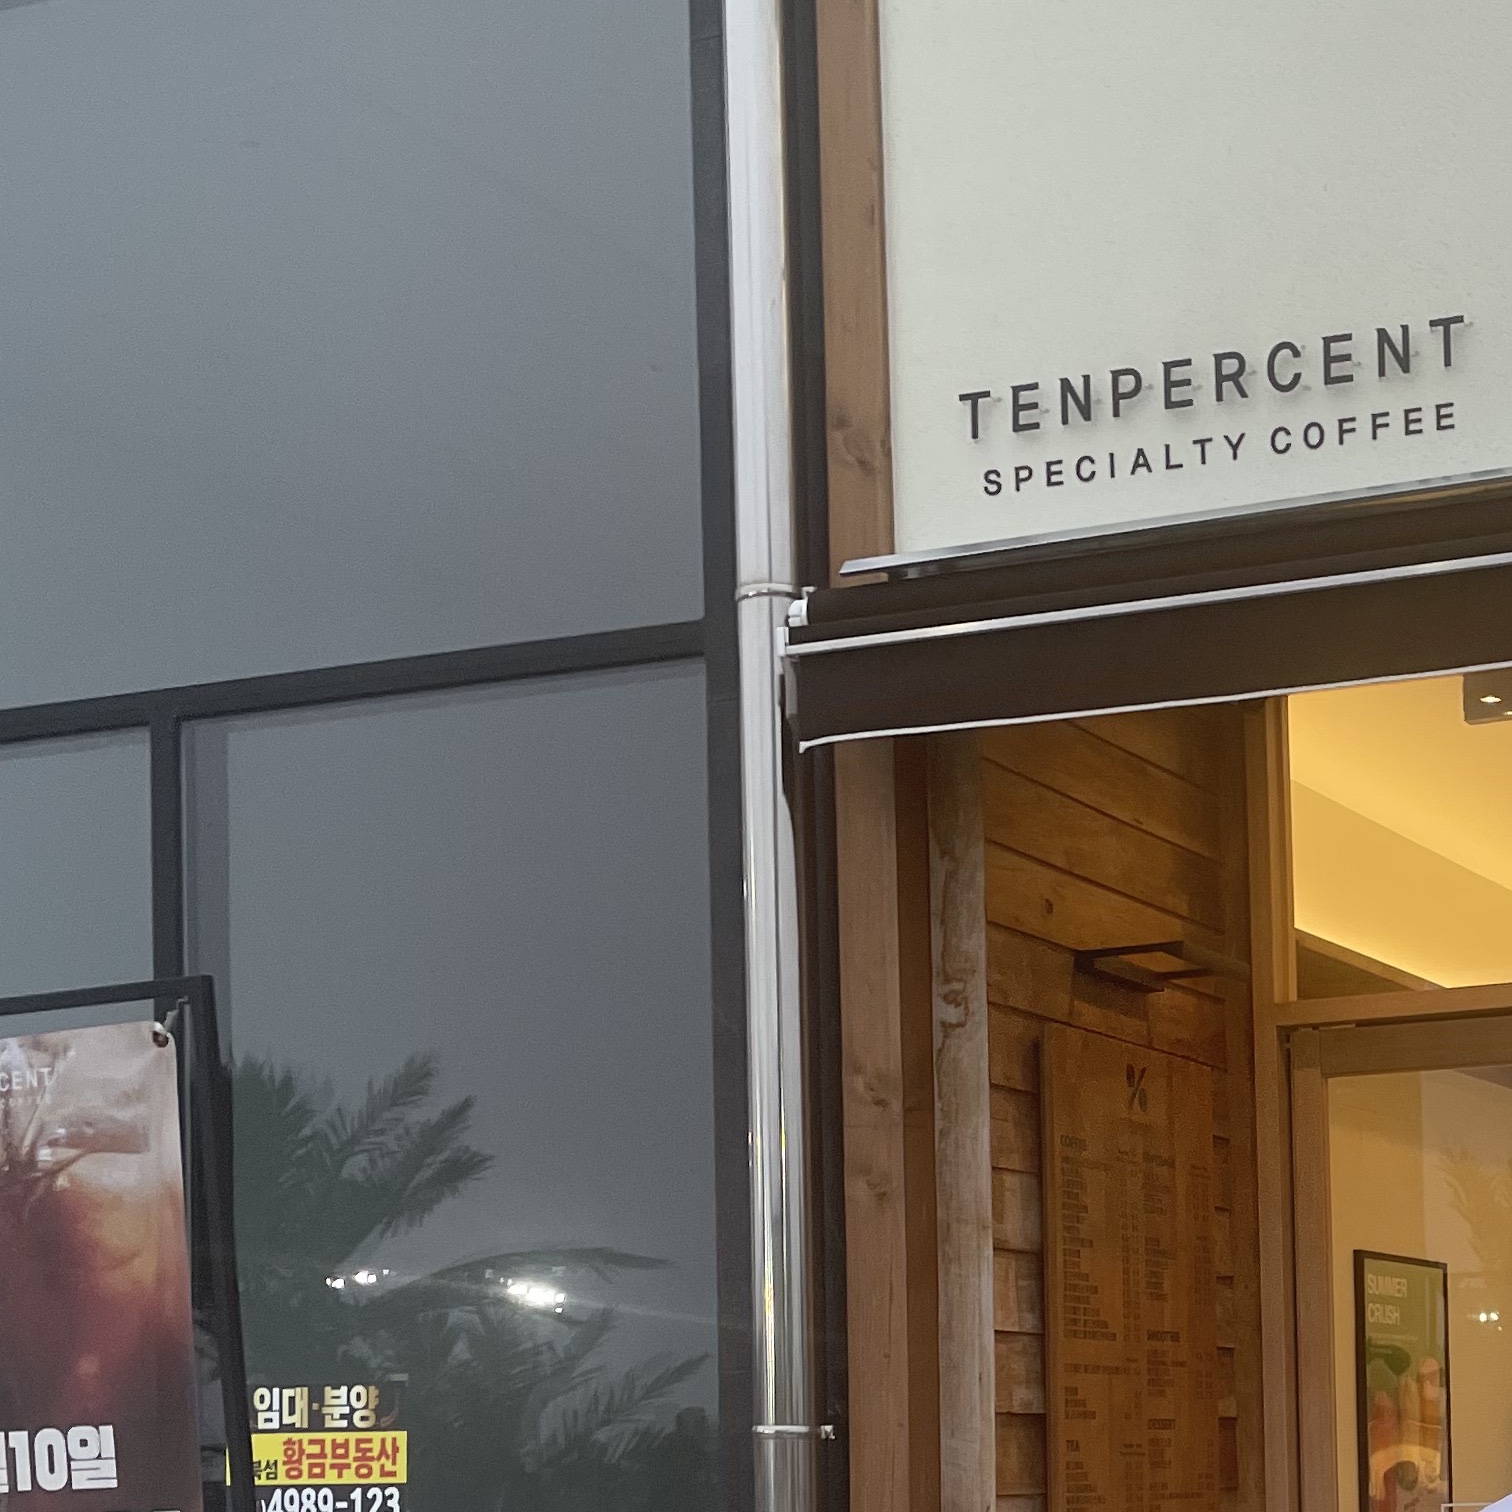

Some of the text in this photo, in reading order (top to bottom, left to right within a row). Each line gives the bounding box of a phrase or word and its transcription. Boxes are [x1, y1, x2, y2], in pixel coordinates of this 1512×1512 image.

[958, 315, 1465, 440] TENPERCENT
[983, 402, 1455, 496] SPECIALTY COFFEE
[1367, 1273, 1408, 1299] SUMMER
[1367, 1303, 1401, 1325] CRUSH
[0, 1424, 117, 1493] 10일
[282, 1436, 400, 1480] 황금부동산
